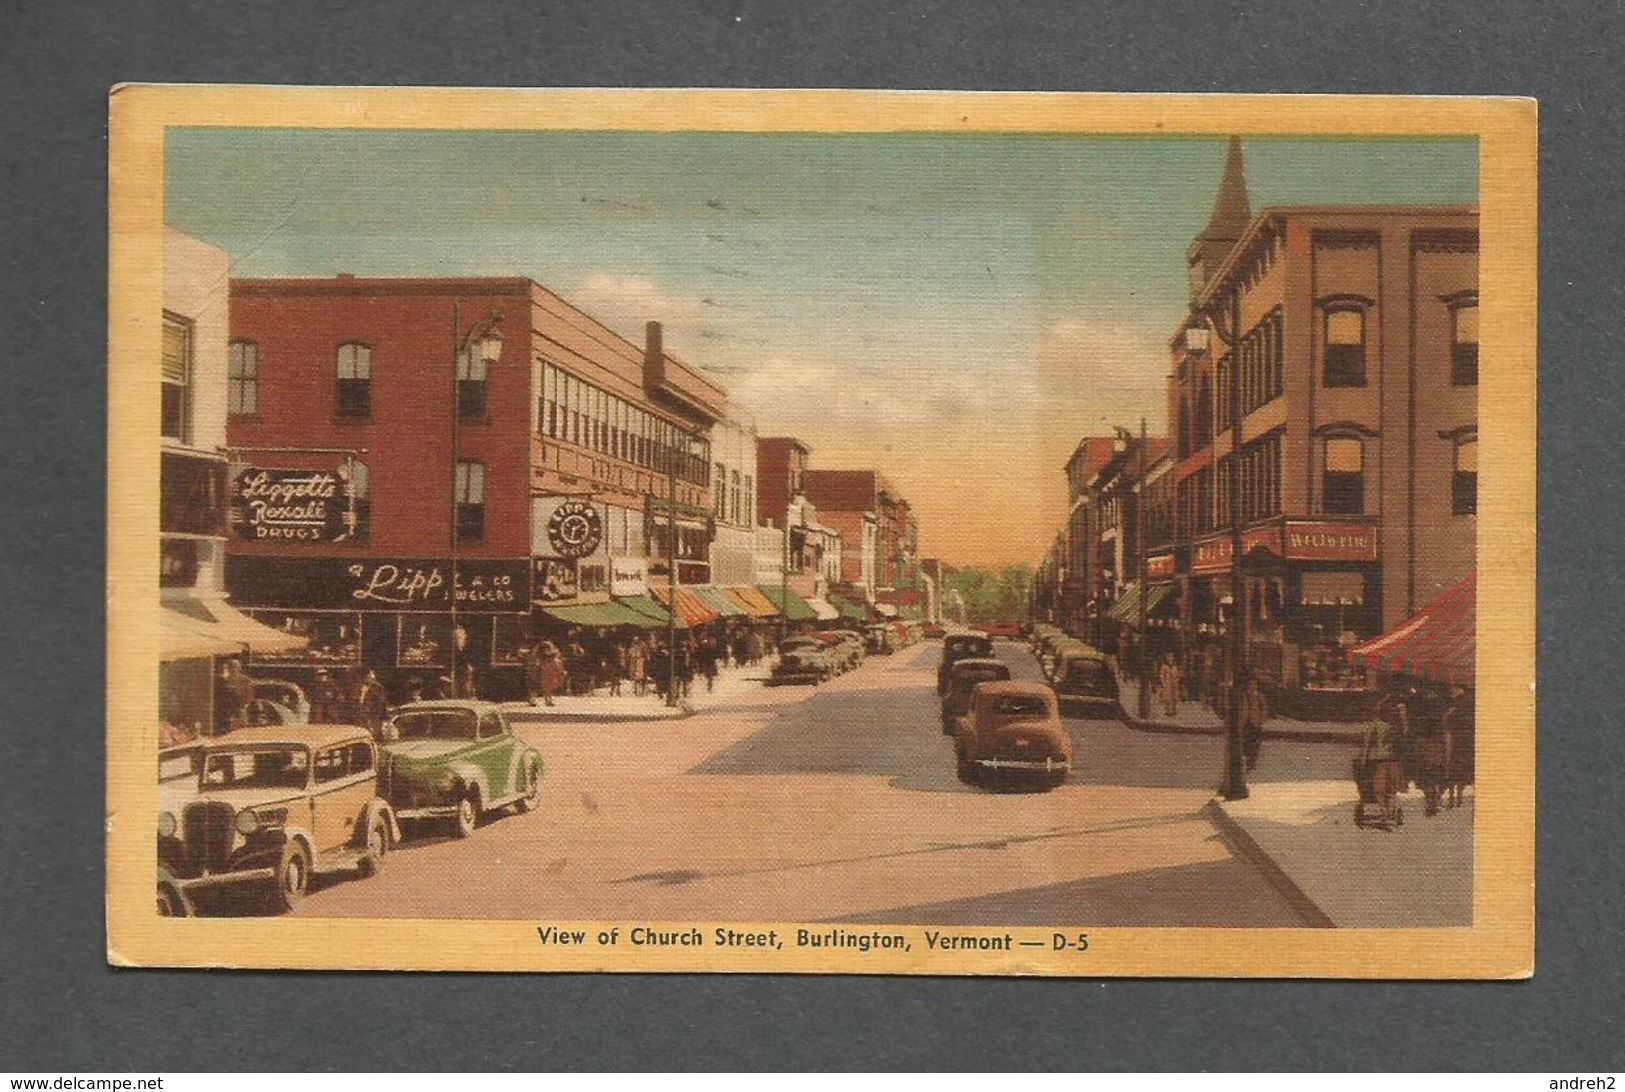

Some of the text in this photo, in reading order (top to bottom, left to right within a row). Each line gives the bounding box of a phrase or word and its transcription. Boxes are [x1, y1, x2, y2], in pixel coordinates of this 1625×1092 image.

[444, 589, 515, 601] JWELERS
[536, 926, 586, 945] View
[598, 927, 619, 945] of
[630, 927, 703, 946] Church
[715, 928, 783, 950] Street,
[797, 929, 911, 953] Burlington,
[924, 931, 1013, 951] Vermont
[1053, 933, 1089, 952] D-5
